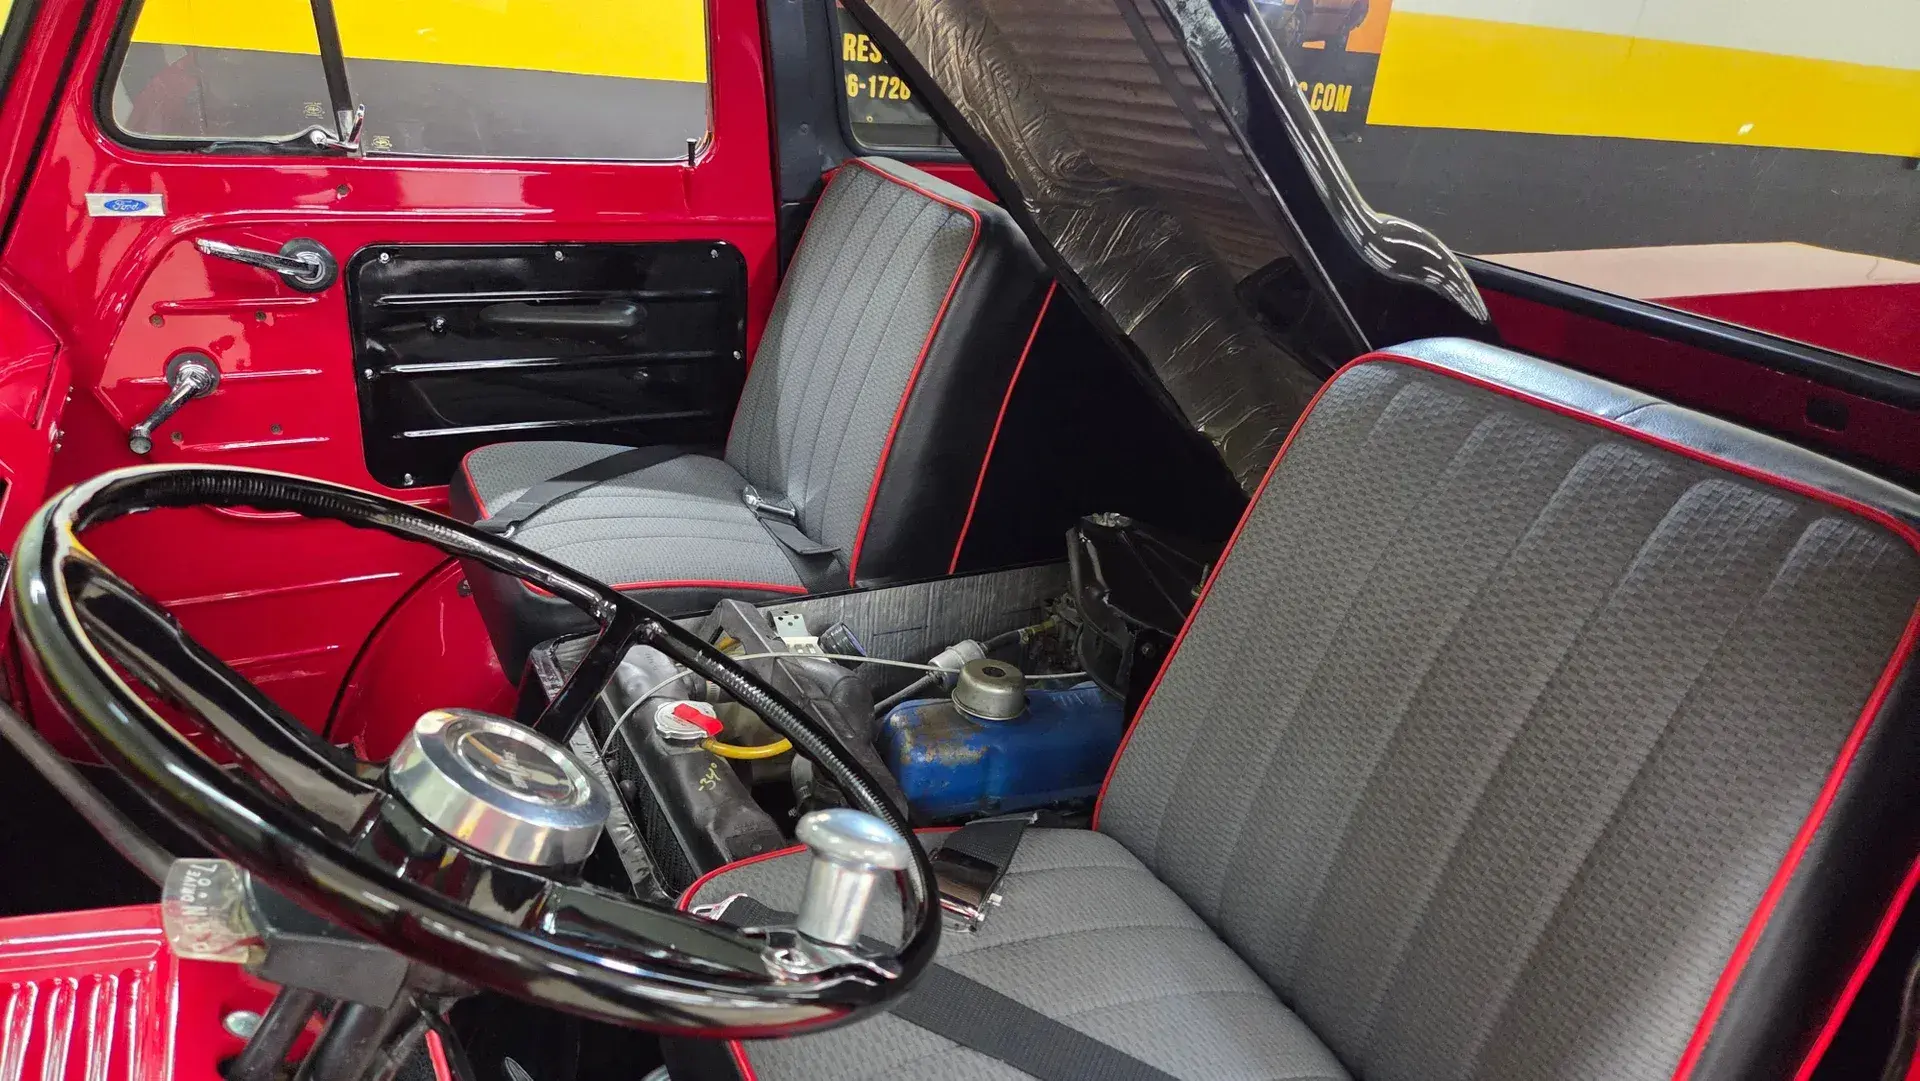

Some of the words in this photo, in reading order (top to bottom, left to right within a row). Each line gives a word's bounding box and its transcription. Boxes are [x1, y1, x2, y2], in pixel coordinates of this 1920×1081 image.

[112, 199, 140, 211] Ford
[189, 863, 218, 874] L
[180, 869, 202, 903] DRIVE
[181, 905, 208, 916] N
